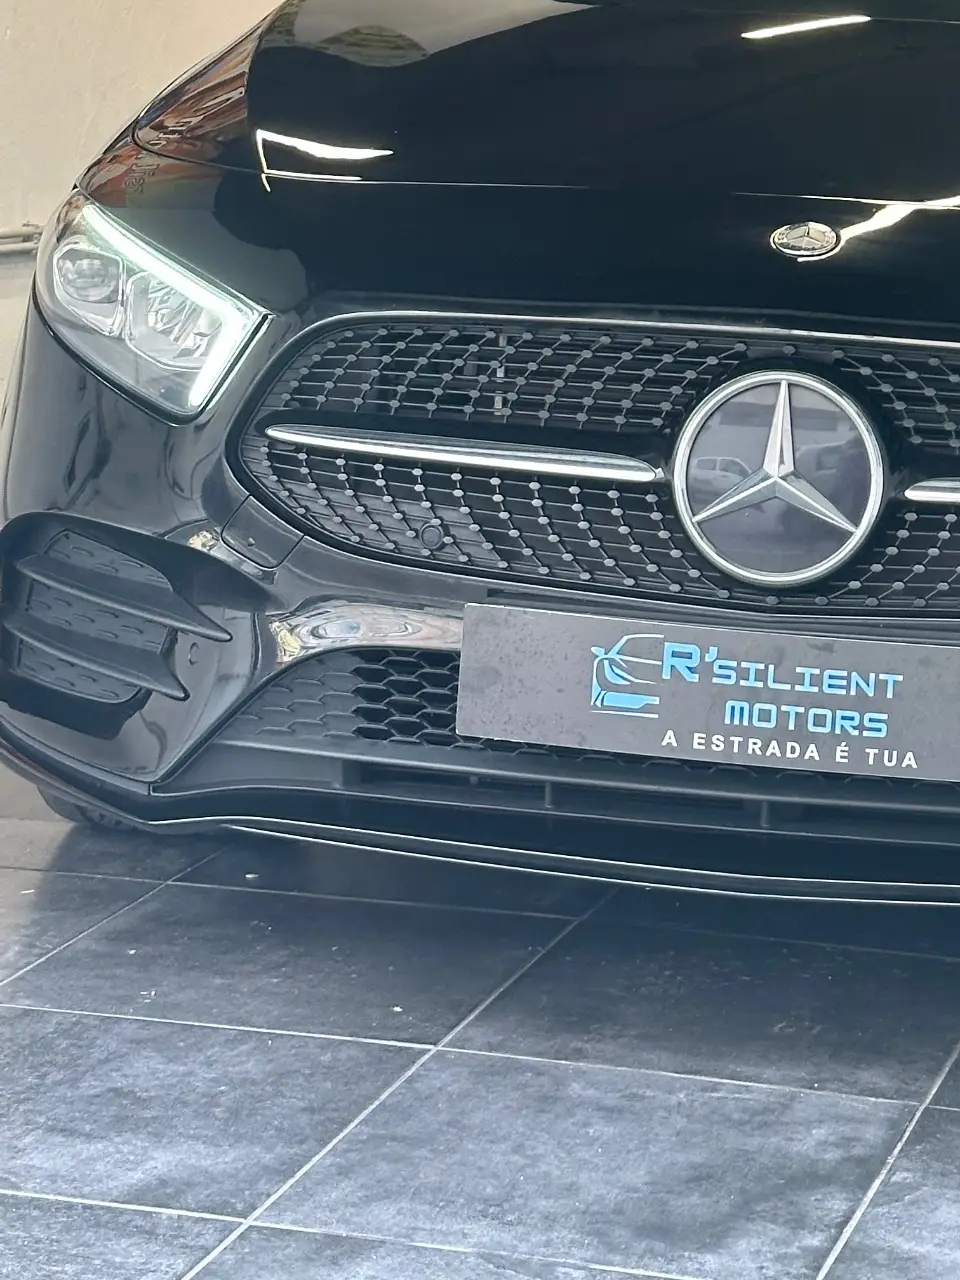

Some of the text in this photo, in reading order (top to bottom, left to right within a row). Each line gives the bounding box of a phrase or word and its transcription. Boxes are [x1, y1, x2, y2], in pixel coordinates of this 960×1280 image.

[662, 641, 904, 699] R'SILIENT
[724, 700, 889, 738] MOTORS
[661, 730, 918, 769] A ESTRADA É TUA
